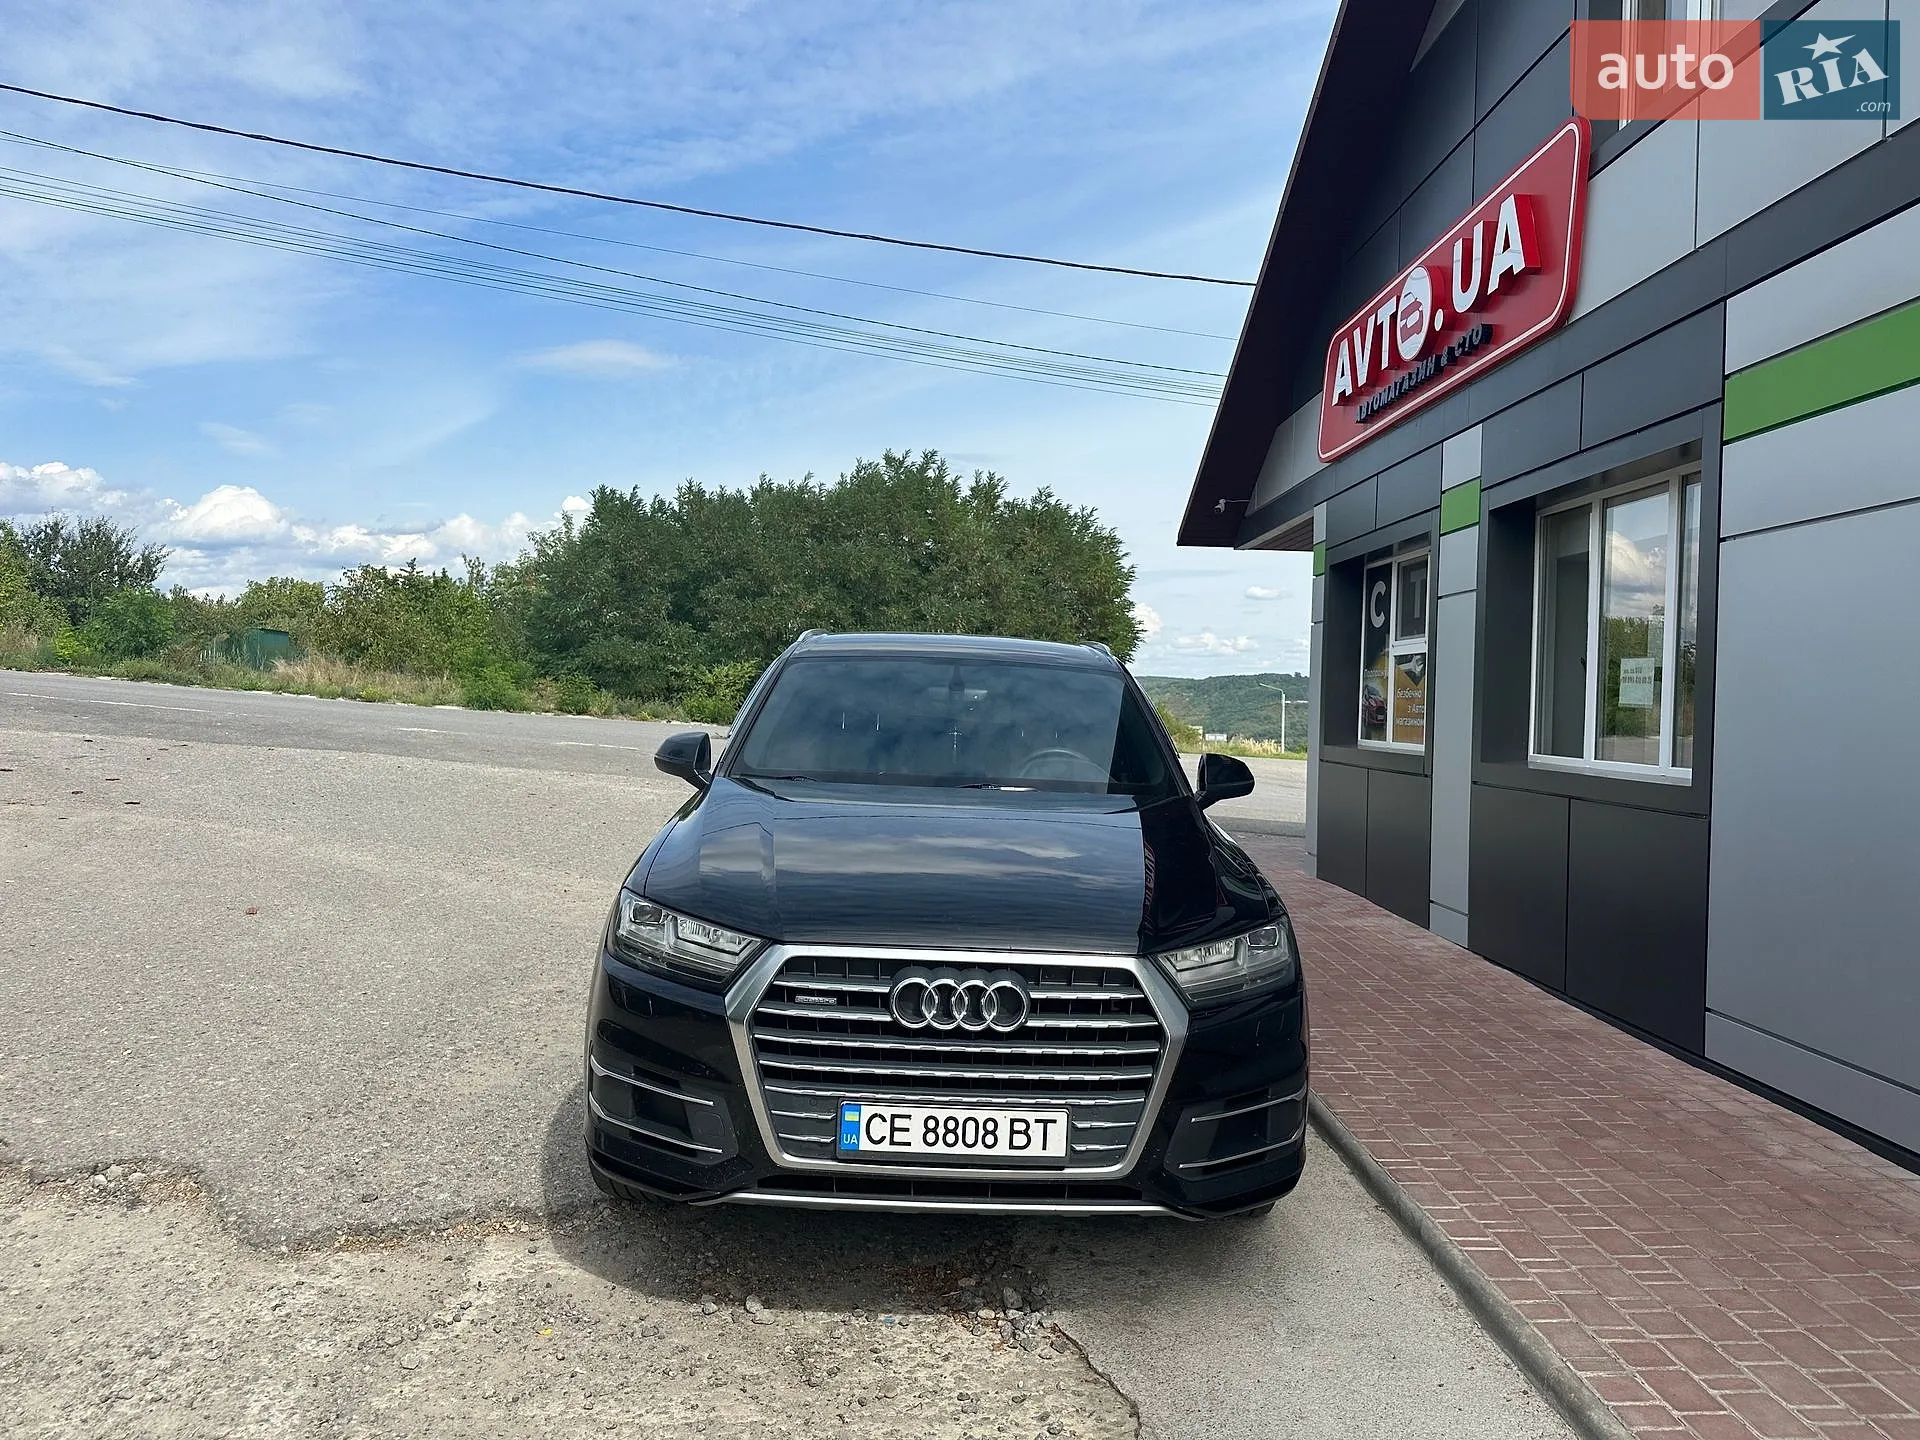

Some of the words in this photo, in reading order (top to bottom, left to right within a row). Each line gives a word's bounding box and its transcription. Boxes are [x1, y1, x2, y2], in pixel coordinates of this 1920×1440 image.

[843, 1133, 858, 1145] UA
[866, 1112, 912, 1147] CE
[922, 1115, 998, 1150] 8808
[1008, 1117, 1057, 1151] BT
